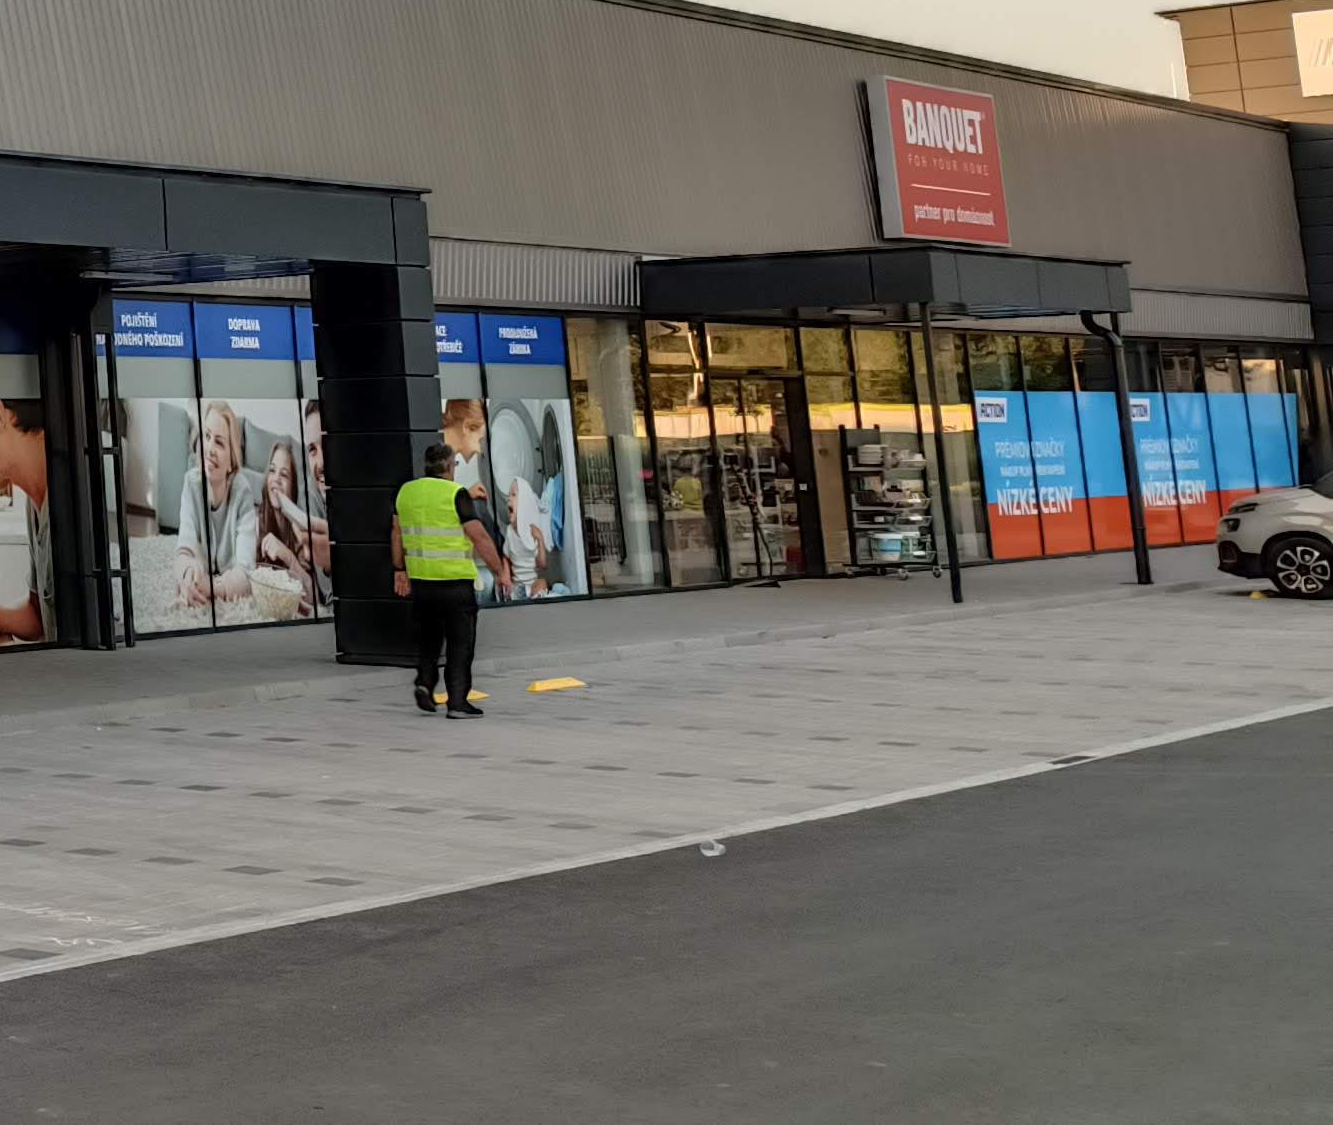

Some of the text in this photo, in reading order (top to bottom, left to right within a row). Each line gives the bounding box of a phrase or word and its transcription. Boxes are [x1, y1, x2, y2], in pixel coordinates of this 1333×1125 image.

[901, 98, 984, 154] BANQUET
[908, 154, 990, 177] FOR YOUR HOME
[121, 312, 158, 328] POJIŠTĚNÍ
[228, 318, 261, 332] DOPRAVA
[144, 331, 184, 347] POŠKOZENÍ
[230, 336, 261, 349] ZDARMA
[997, 479, 1073, 516] NÍZKÉ CENY
[1142, 475, 1207, 507] NÍZKÉ CENY
